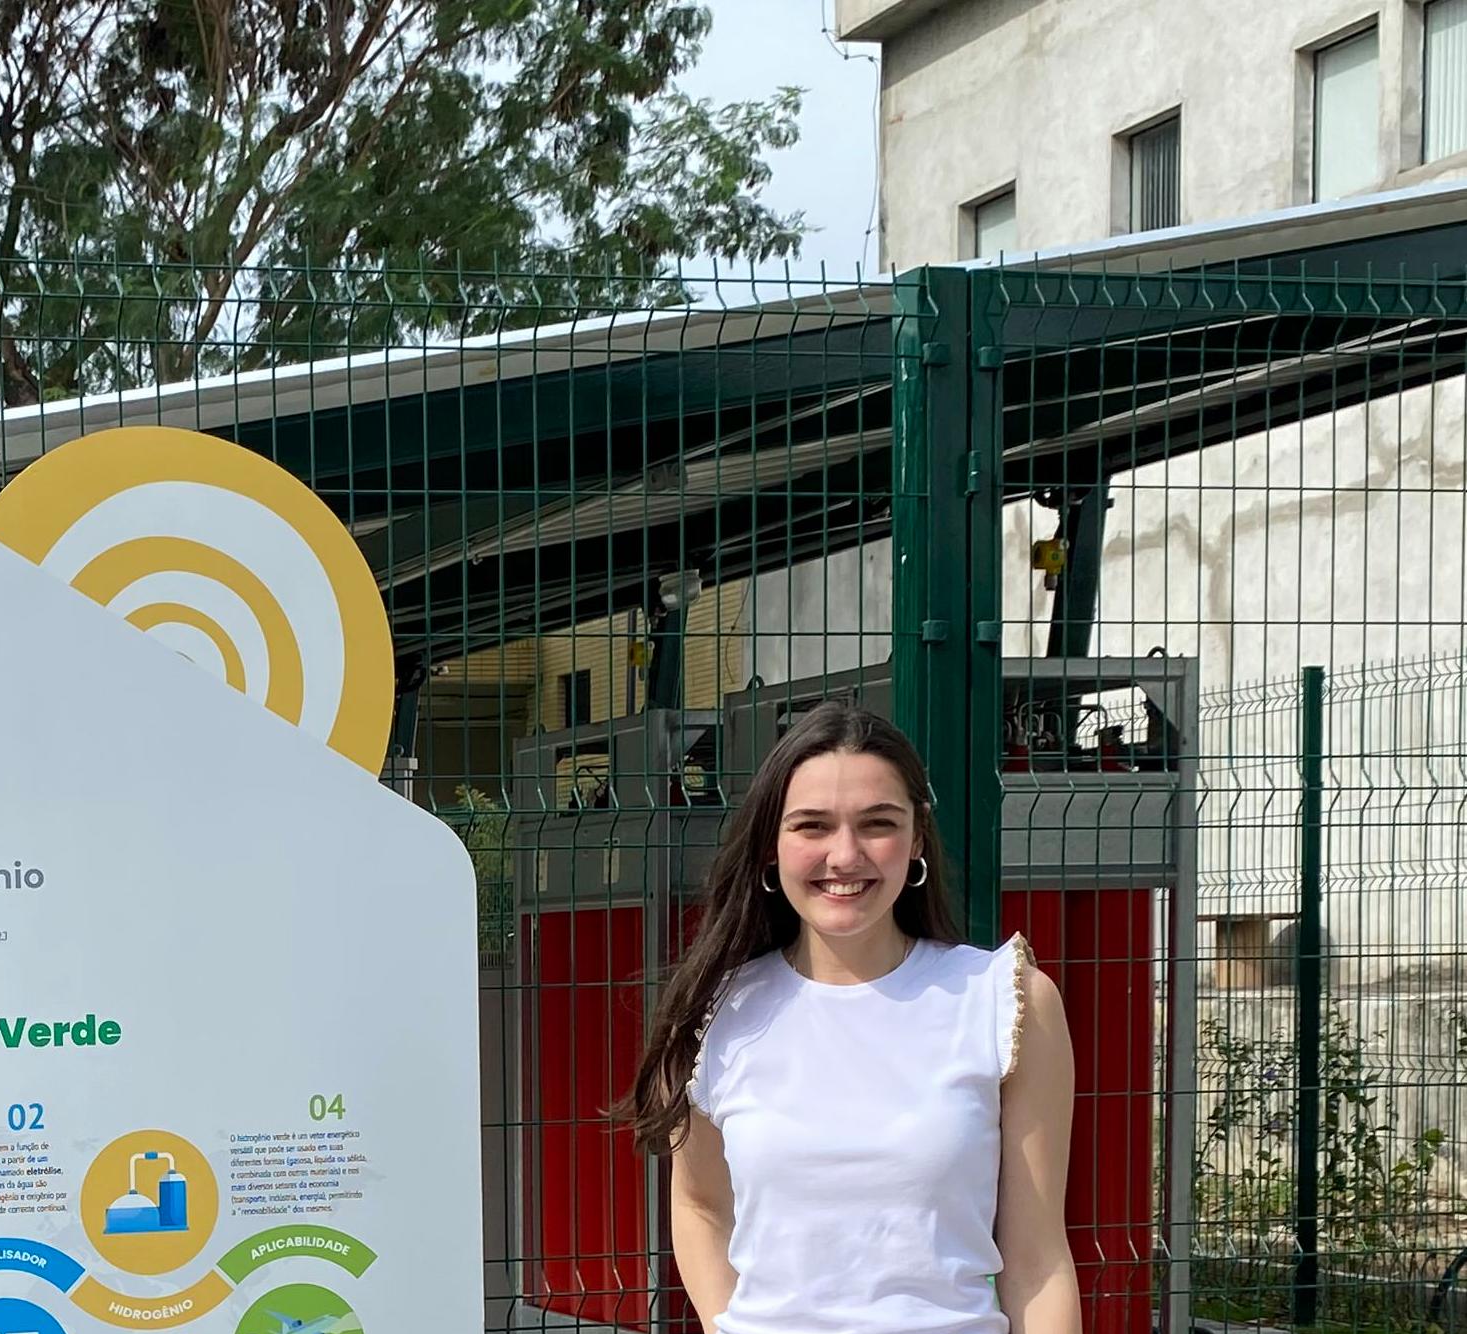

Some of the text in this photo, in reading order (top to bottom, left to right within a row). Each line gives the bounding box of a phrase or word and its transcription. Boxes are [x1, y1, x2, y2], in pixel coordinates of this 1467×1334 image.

[7, 1103, 45, 1131] 02
[309, 1094, 346, 1121] 04
[250, 1236, 351, 1261] APLICABILIDADE
[108, 1299, 194, 1321] HIDROGÊNIO
